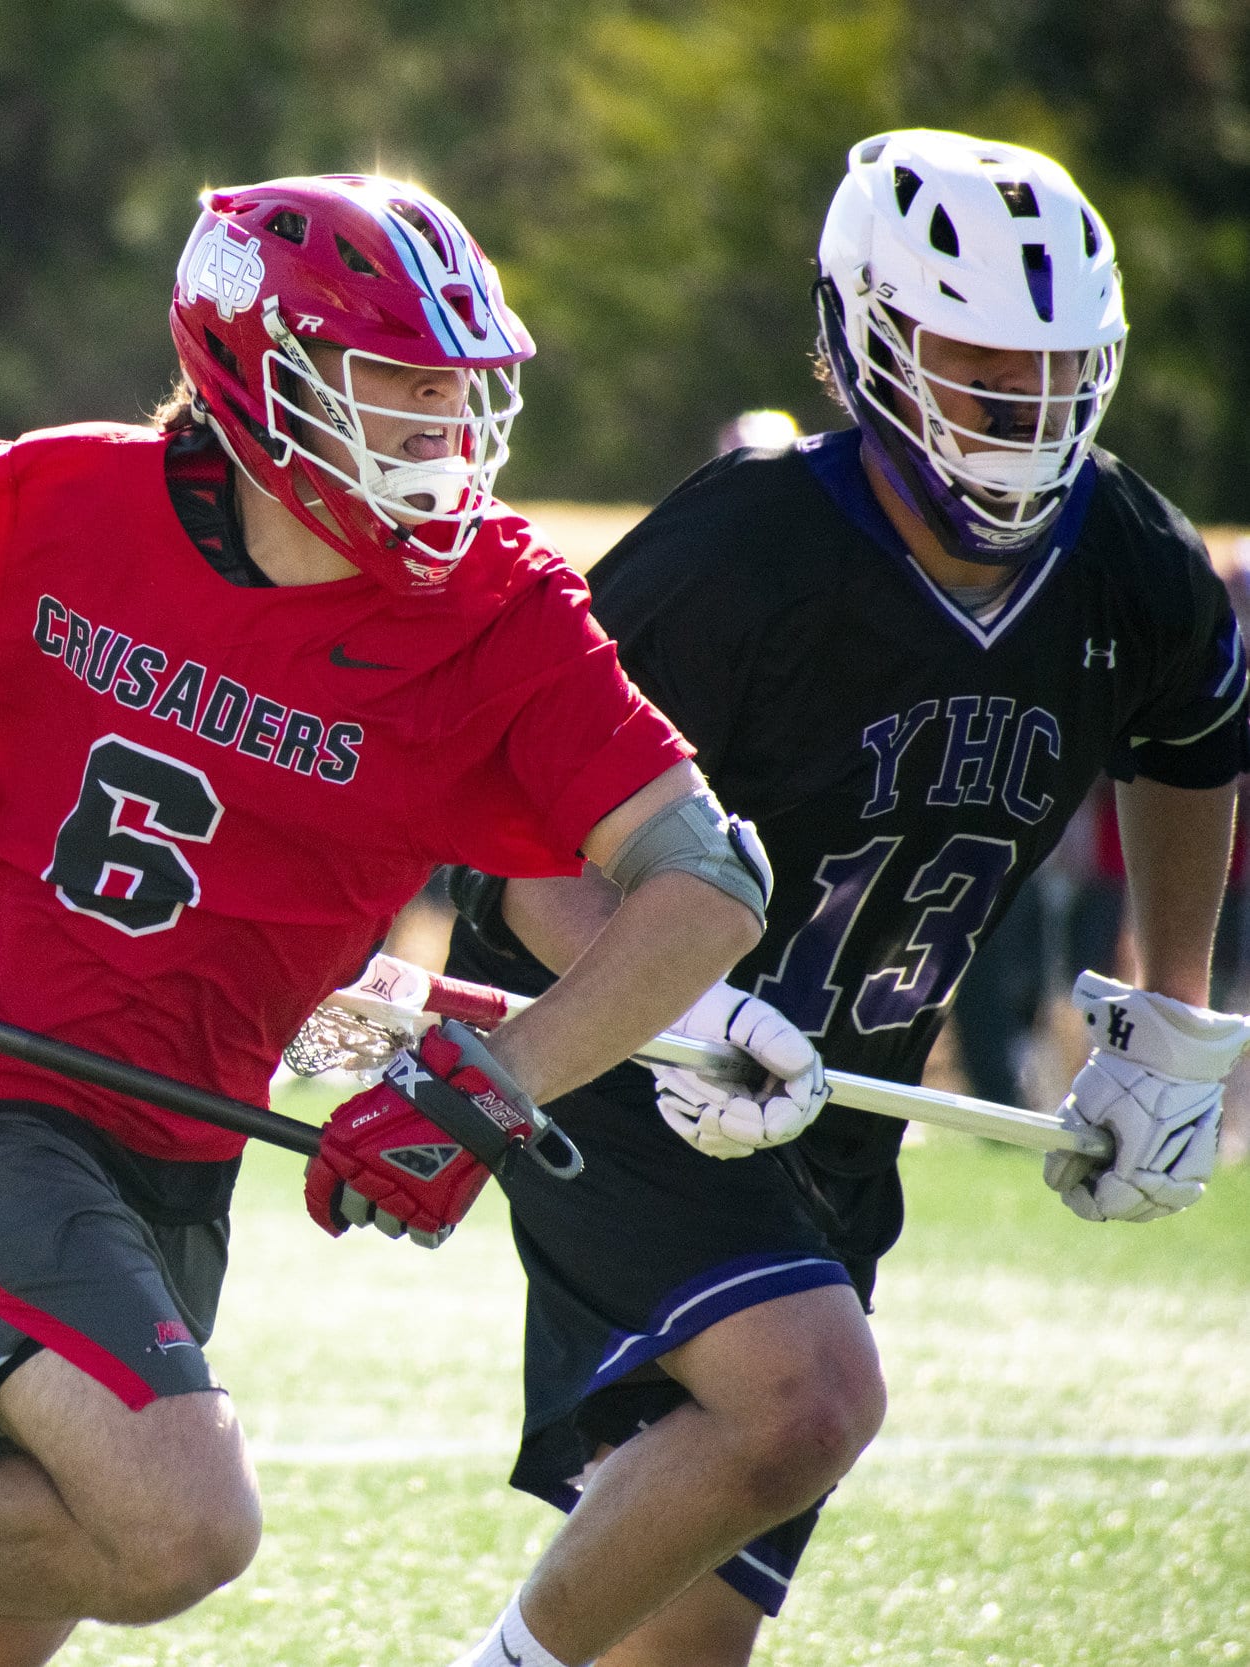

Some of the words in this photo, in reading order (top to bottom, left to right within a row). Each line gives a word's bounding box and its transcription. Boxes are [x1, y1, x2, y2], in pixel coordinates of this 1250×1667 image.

[34, 593, 364, 785] CRUSADERS
[860, 696, 1061, 825] YHC
[40, 732, 225, 938] 6
[753, 834, 1016, 1037] 13
[352, 1111, 380, 1128] CELL
[474, 1090, 527, 1128] NGU
